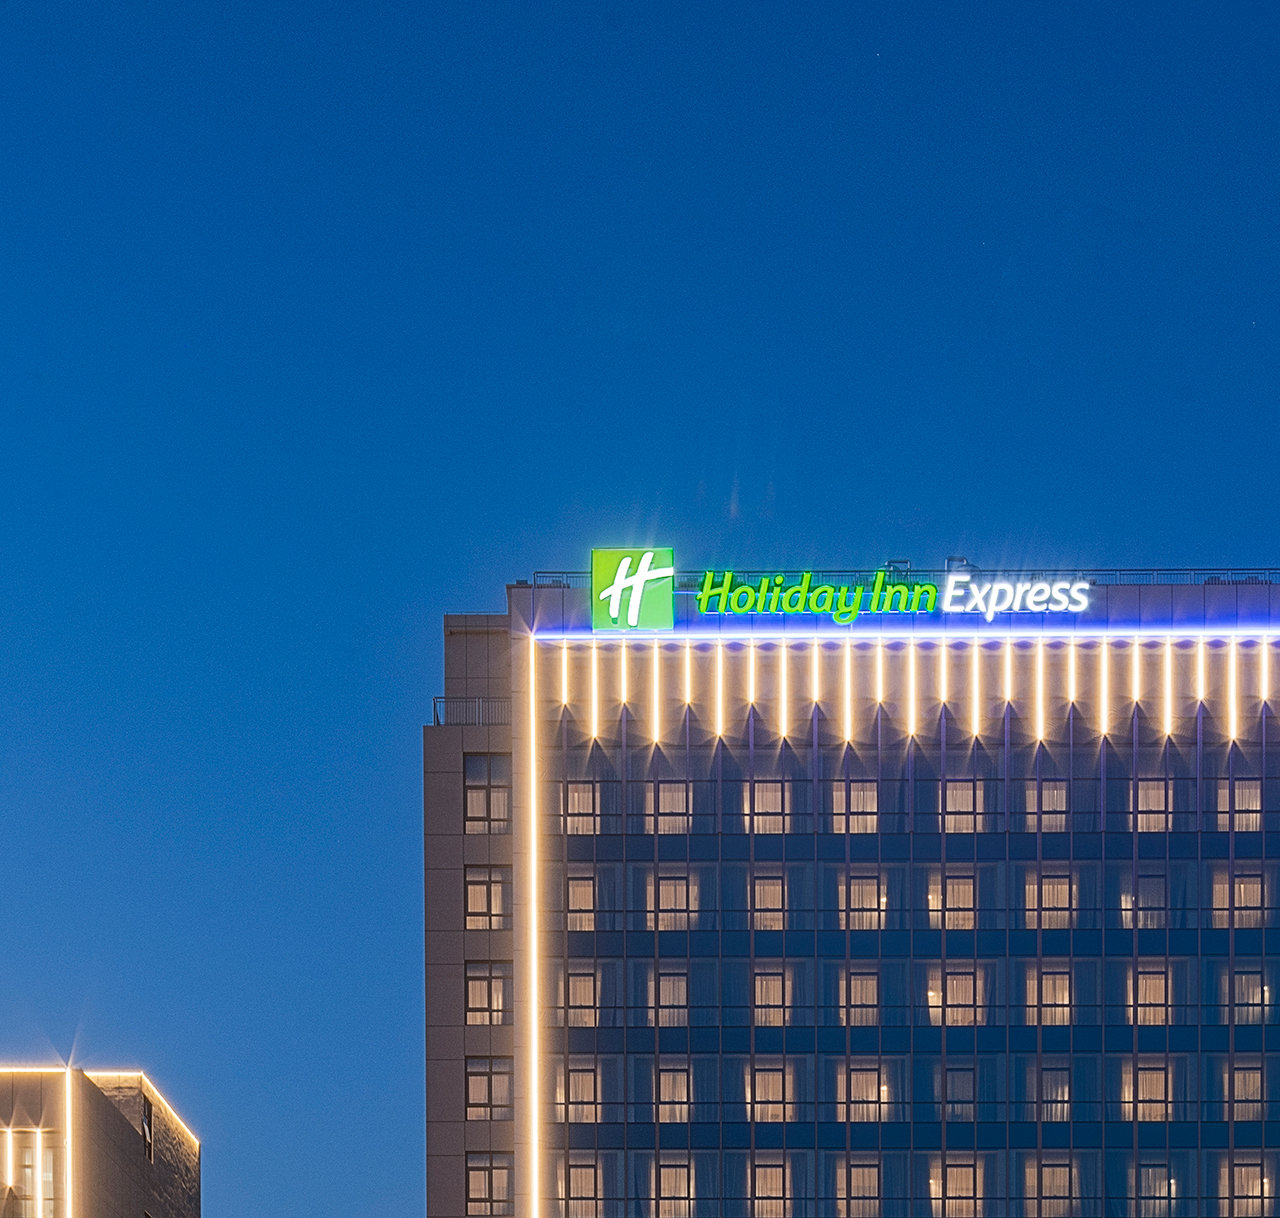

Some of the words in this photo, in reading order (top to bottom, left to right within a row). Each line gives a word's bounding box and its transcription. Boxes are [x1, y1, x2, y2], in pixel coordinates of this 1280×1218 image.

[695, 570, 863, 624] Holiday
[870, 569, 937, 613] Inn
[942, 574, 1090, 623] Express
